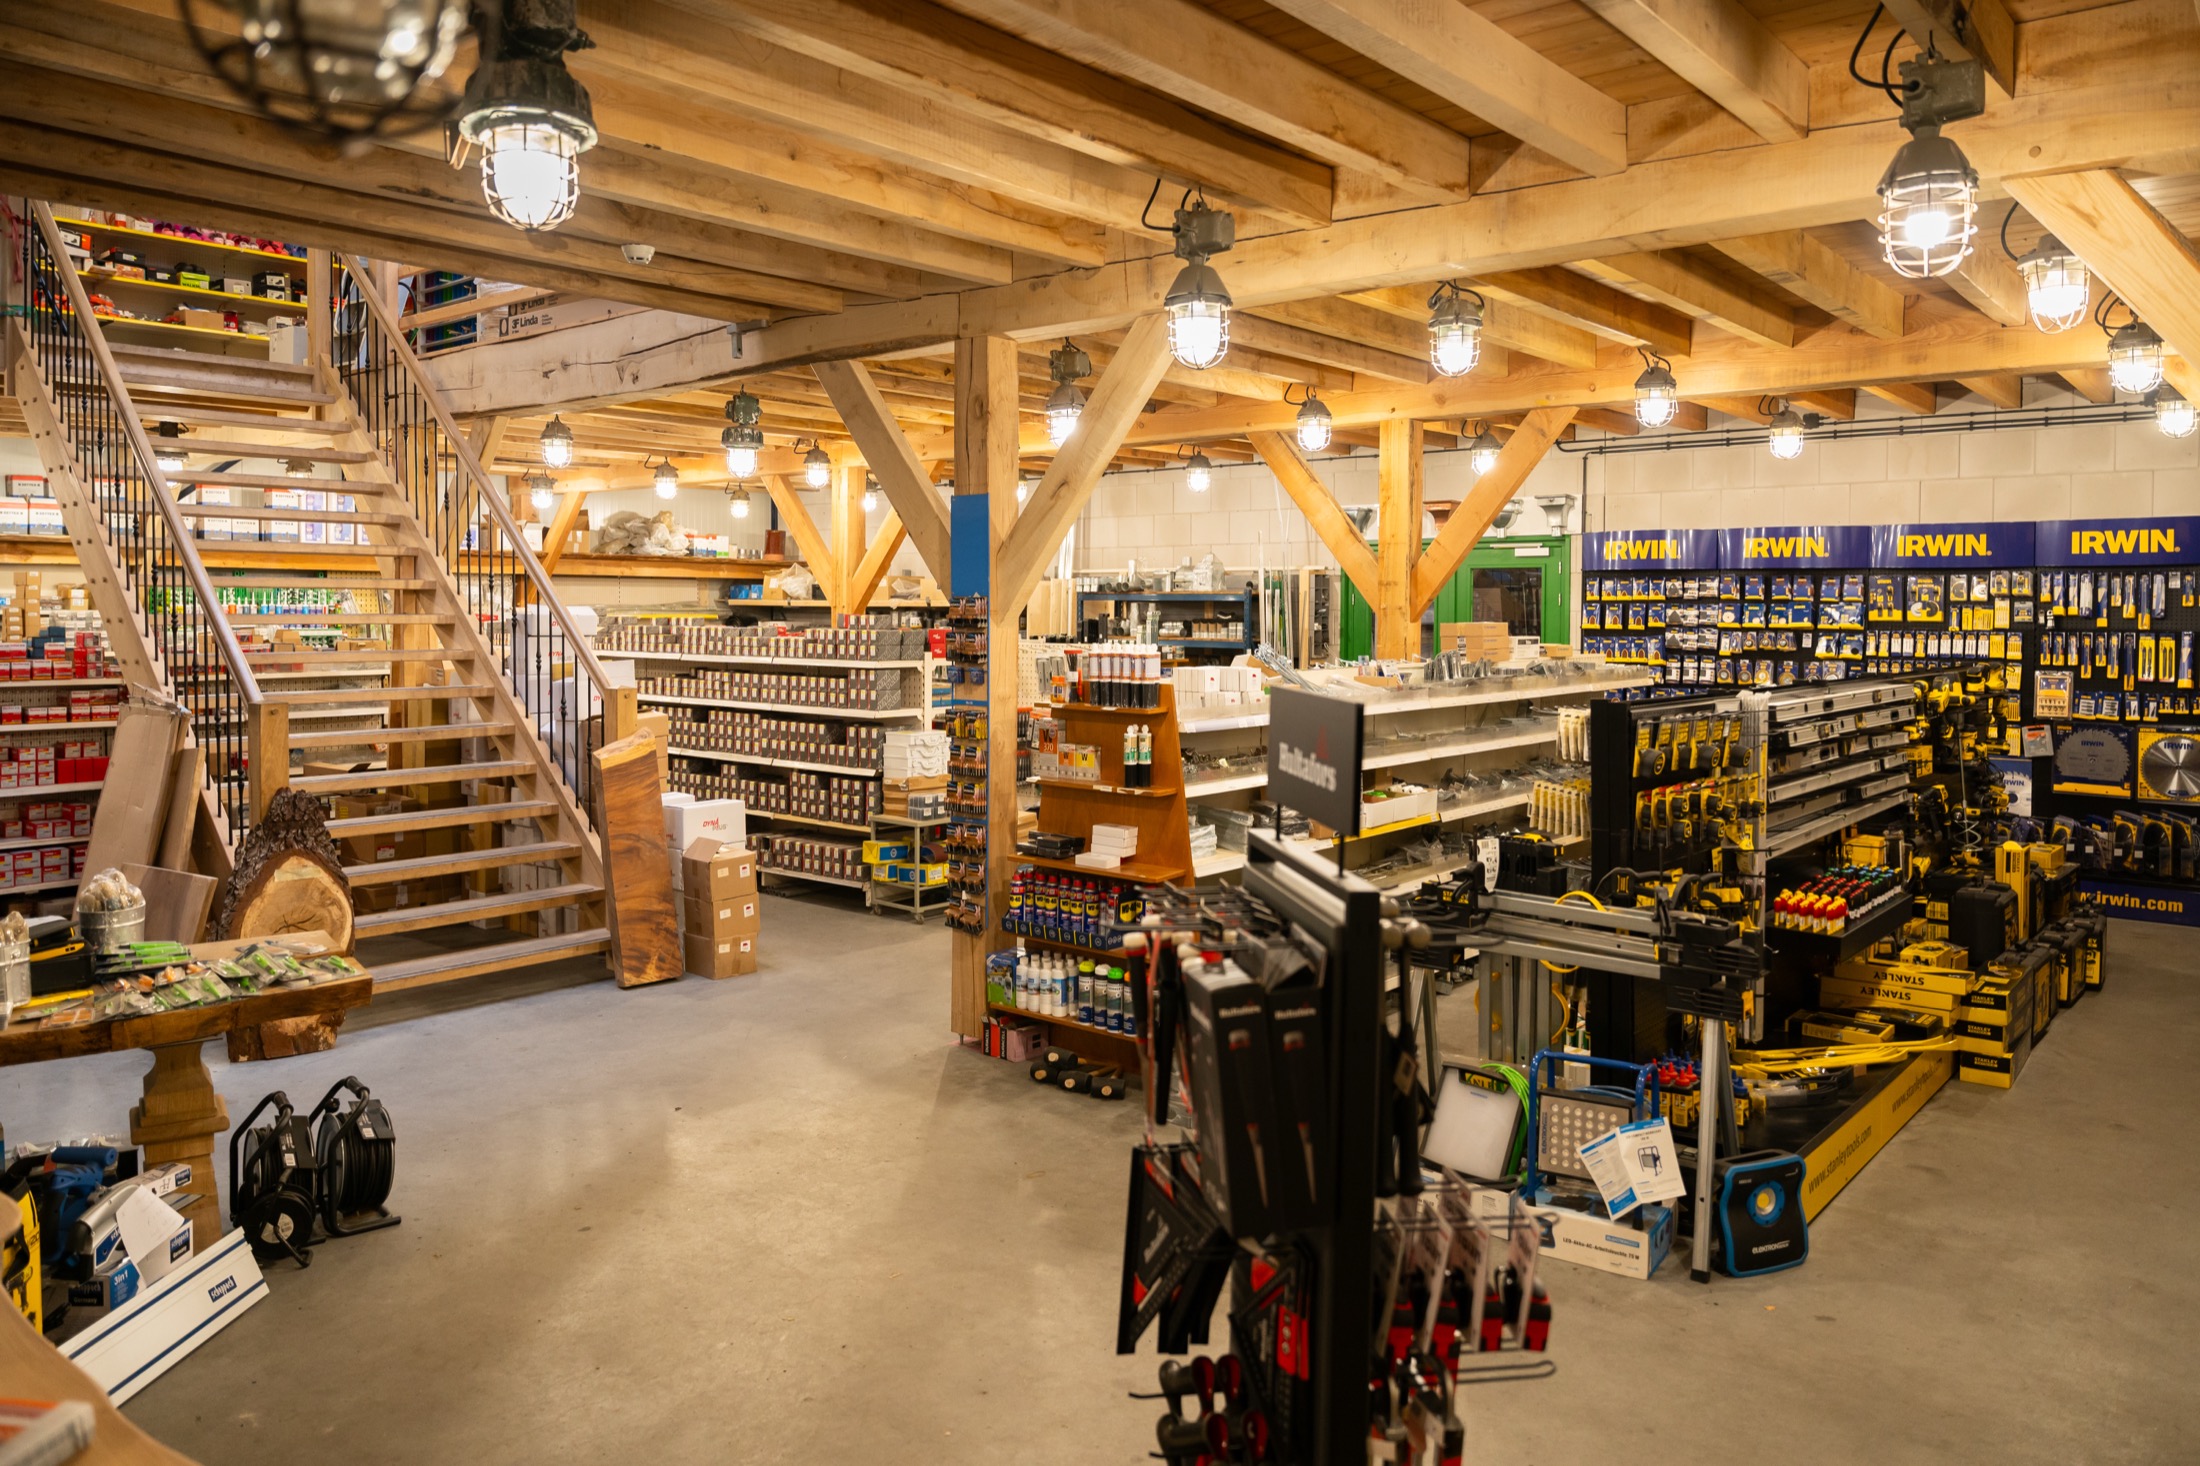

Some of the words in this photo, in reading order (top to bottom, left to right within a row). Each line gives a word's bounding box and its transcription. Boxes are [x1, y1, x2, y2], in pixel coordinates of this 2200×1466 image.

[520, 314, 539, 327] Linda
[1604, 539, 1679, 560] IRWIN
[1743, 536, 1825, 559] IRWIN
[1897, 533, 1987, 557] IRWIN
[2071, 529, 2176, 555] IRWIN
[2081, 740, 2105, 748] IRWIN
[2164, 742, 2194, 750] IRWIN
[2003, 779, 2025, 787] RWIN
[1873, 971, 1925, 986] STANLEY
[1860, 986, 1911, 1001] STANLEY
[1967, 1024, 1991, 1032] STANLEY
[1974, 1056, 1998, 1064] STANLEY
[1808, 1125, 1872, 1195] www.stanleytools.com
[114, 1269, 128, 1286] 3in1
[210, 1275, 235, 1300] scheppach
